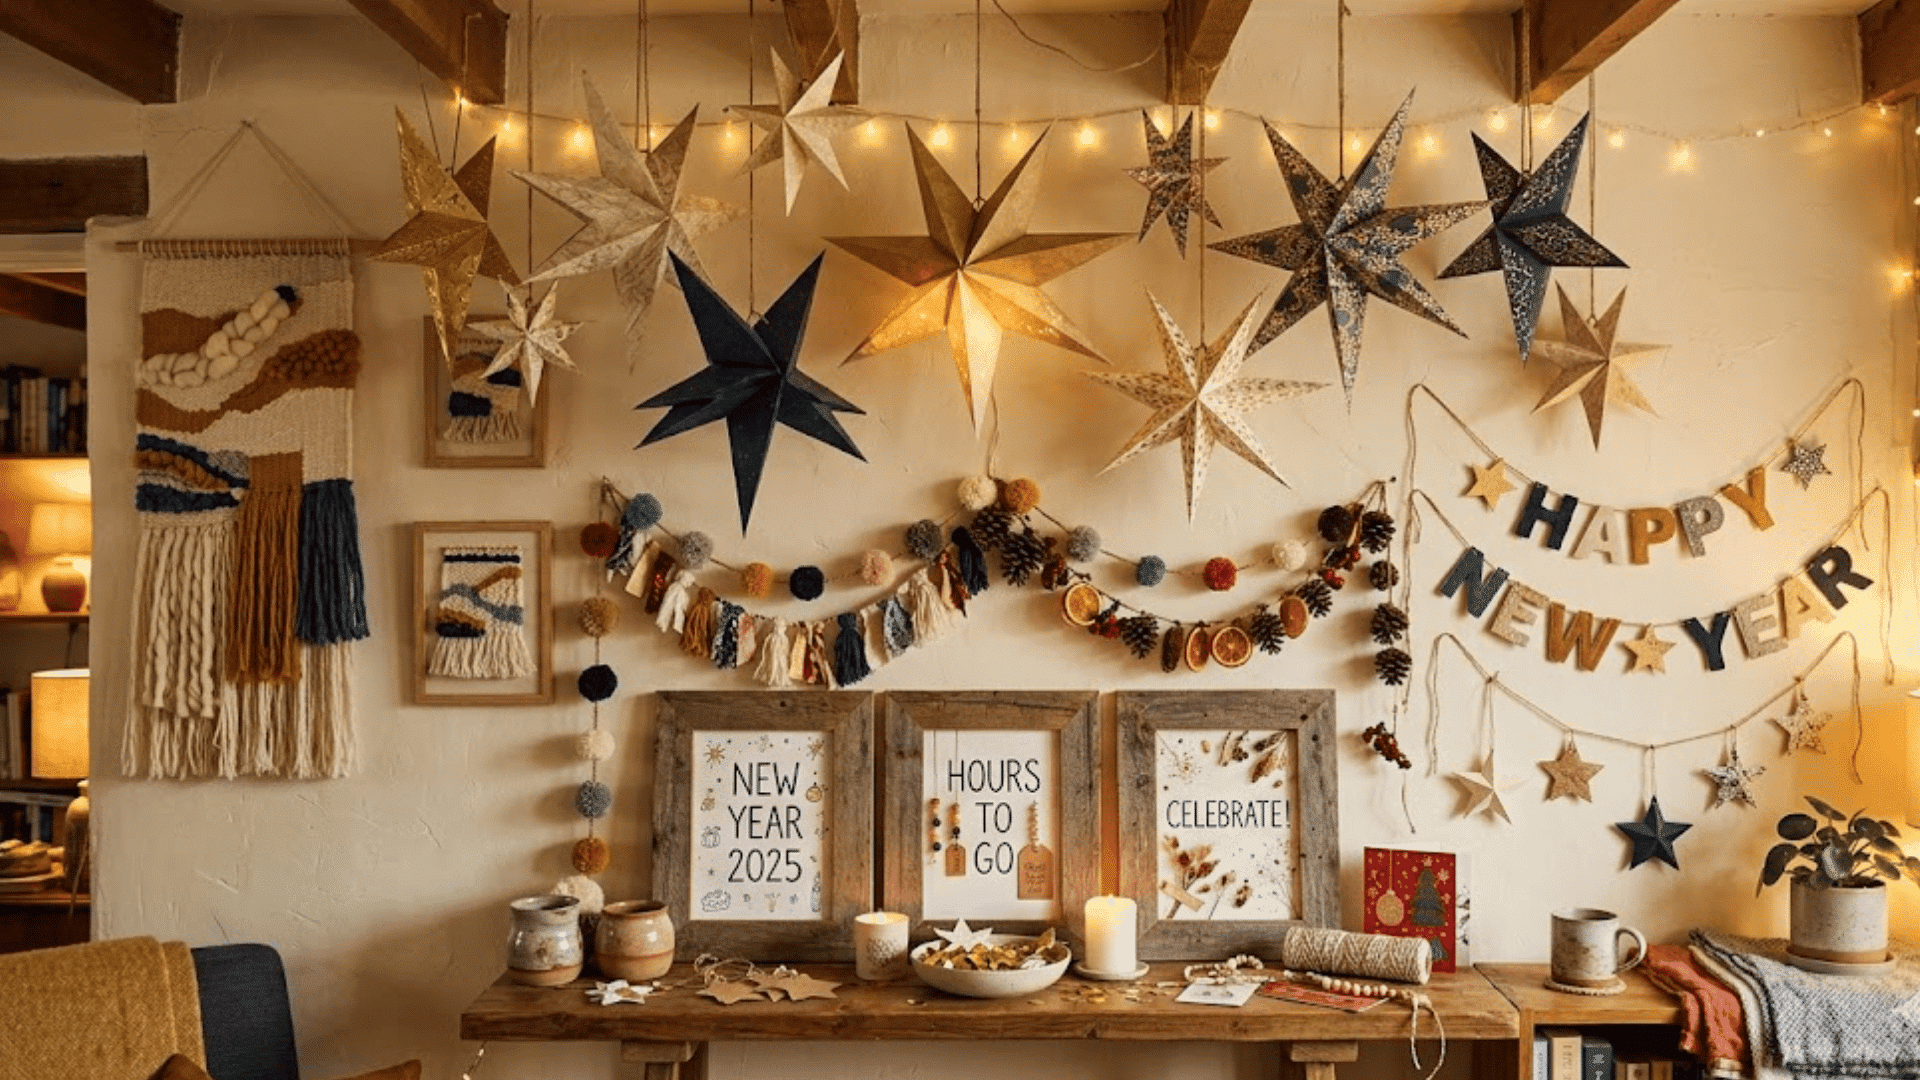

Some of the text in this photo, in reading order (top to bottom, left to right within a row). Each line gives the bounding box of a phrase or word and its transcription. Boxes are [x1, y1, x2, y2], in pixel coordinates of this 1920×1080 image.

[1516, 467, 1774, 565] HAPPY
[1439, 547, 1873, 672] NEW YEAR
[732, 762, 800, 796] NEW
[947, 758, 1041, 793] HOURS
[728, 806, 803, 839] YEAR
[975, 802, 1012, 834] TO
[1166, 800, 1291, 829] CELEBRATE!
[728, 848, 803, 883] 2025
[974, 842, 1014, 875] GO
